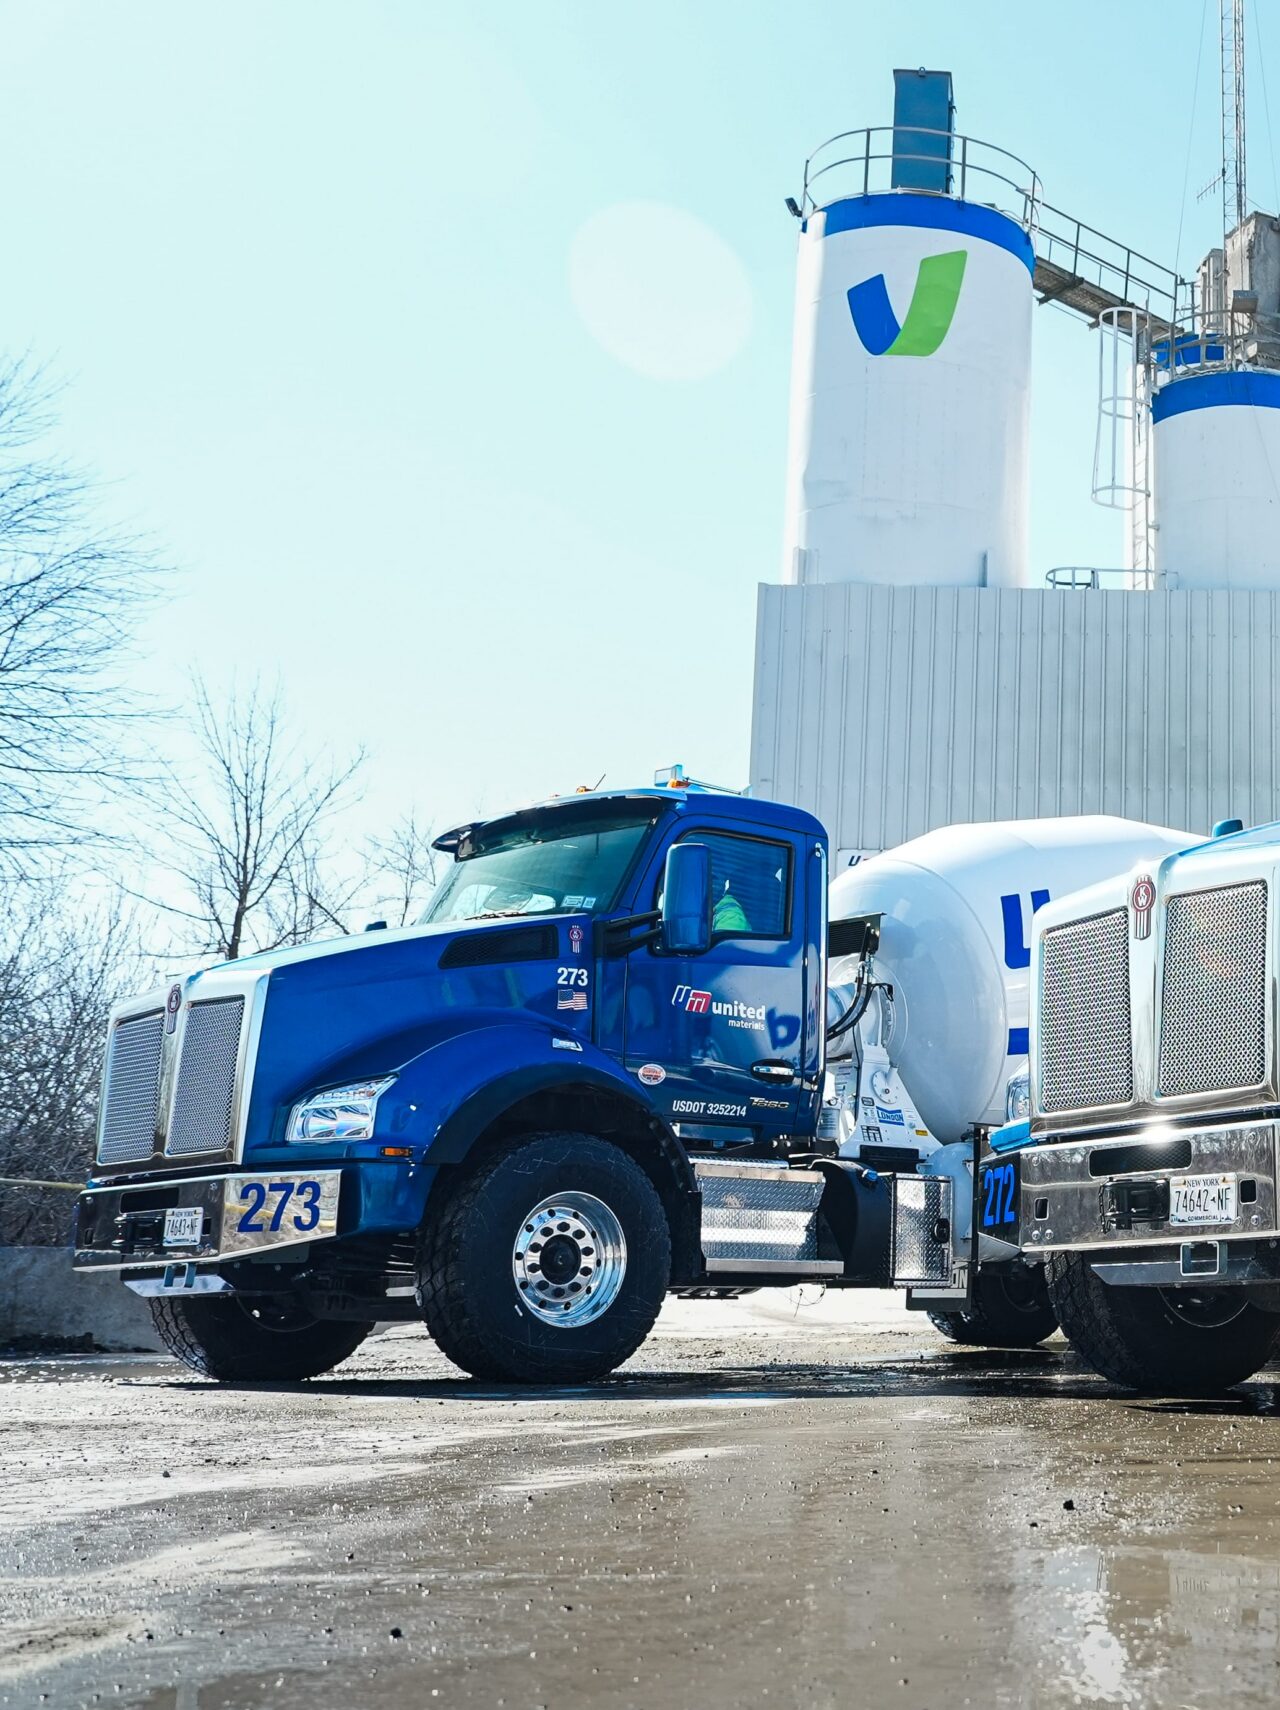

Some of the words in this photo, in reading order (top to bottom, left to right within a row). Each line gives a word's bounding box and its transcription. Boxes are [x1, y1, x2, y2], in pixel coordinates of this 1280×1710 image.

[557, 967, 588, 986] 273
[712, 1000, 766, 1020] united
[728, 1019, 766, 1031] materials
[672, 1099, 706, 1114] USDOT
[707, 1103, 747, 1117] 3252214
[877, 1109, 904, 1122] LONDON
[1187, 1179, 1202, 1187] NEW
[1203, 1178, 1220, 1187] YORK
[983, 1163, 1016, 1227] 272
[237, 1181, 321, 1233] 273
